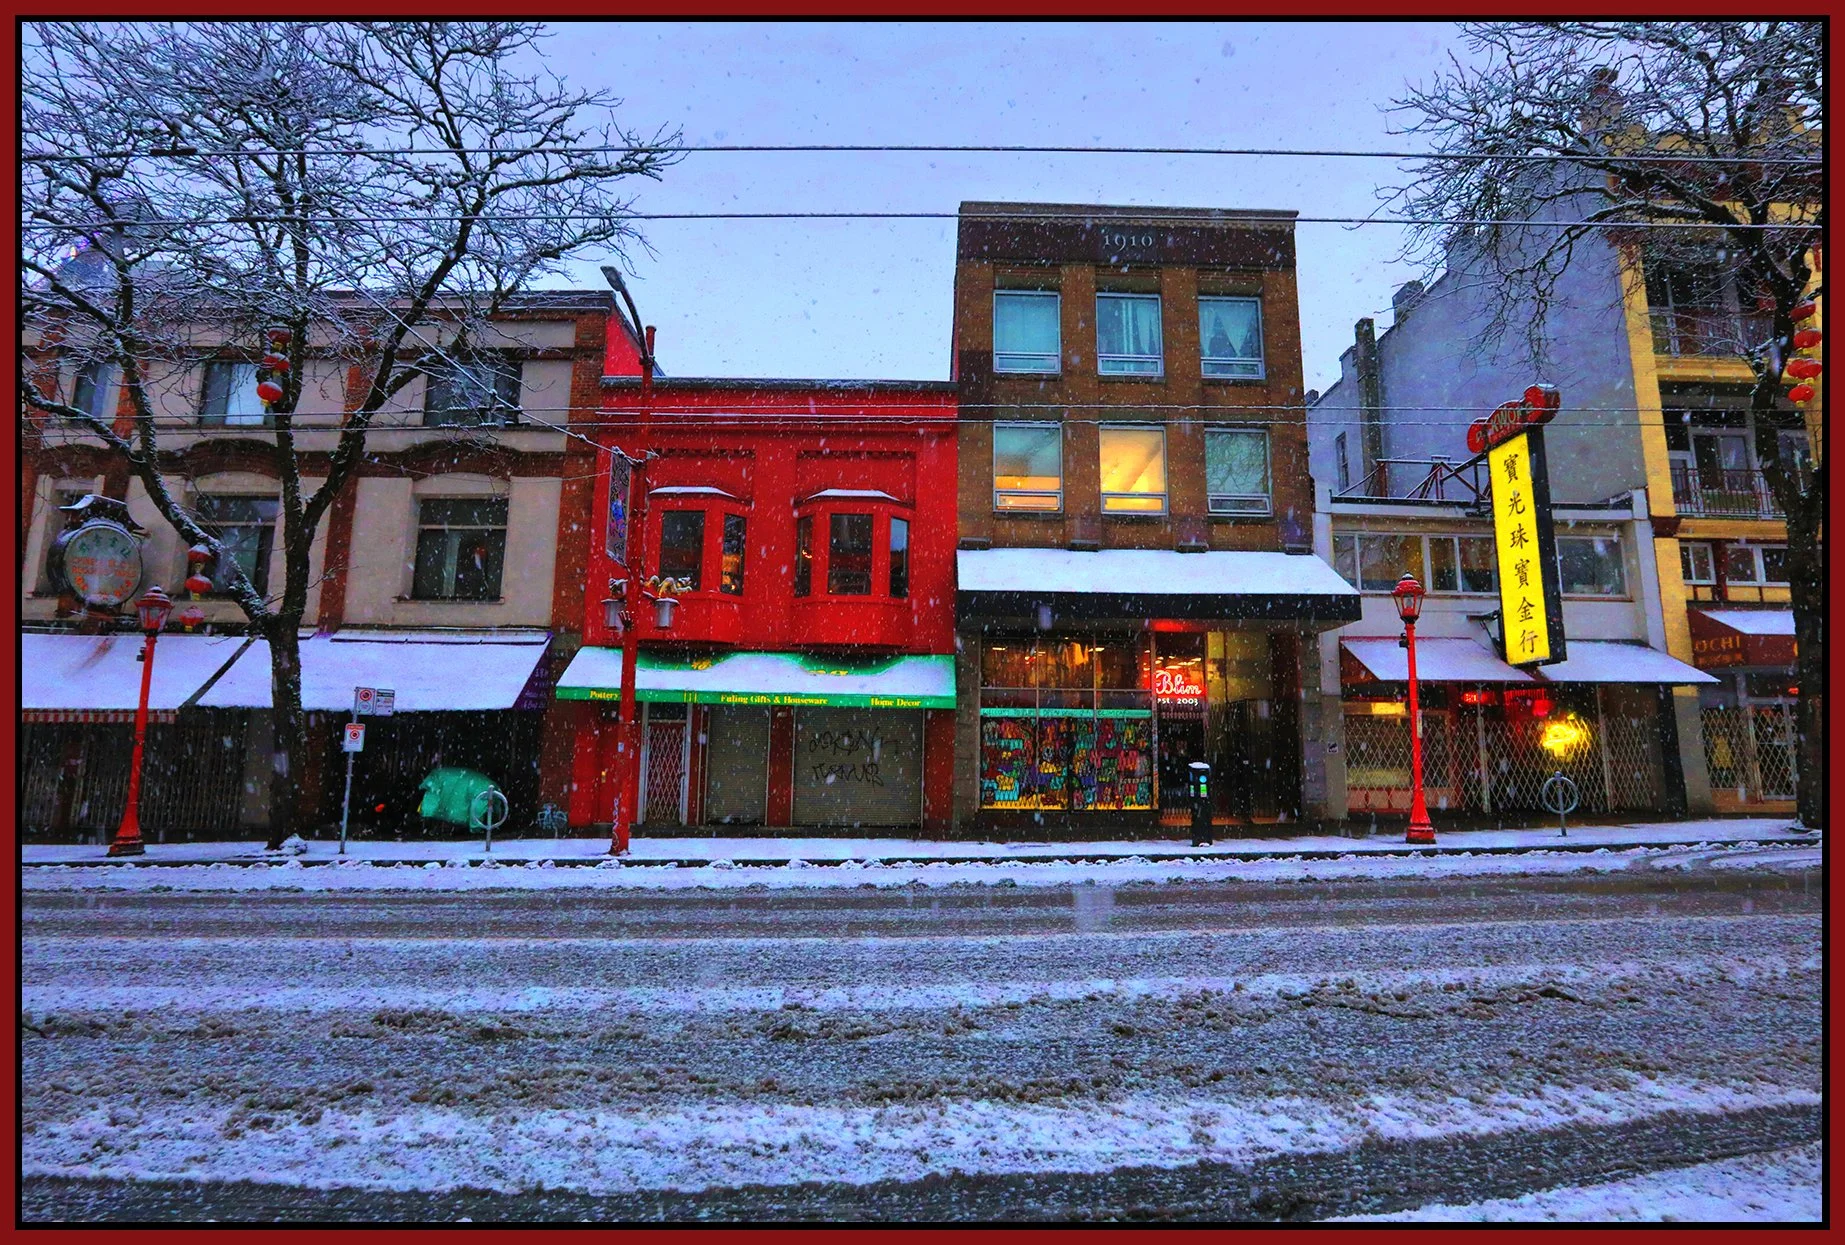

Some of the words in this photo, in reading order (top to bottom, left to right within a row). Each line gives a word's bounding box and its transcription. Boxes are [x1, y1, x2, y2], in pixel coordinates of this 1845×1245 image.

[1104, 234, 1153, 252] 1910
[1503, 453, 1540, 654] 寶光珠寶金行
[1155, 670, 1202, 694] Blim
[590, 690, 618, 700] Pottery
[750, 695, 771, 703] Gifts
[774, 696, 781, 704] &
[784, 696, 828, 704] Houseware
[871, 697, 894, 706] Home
[896, 698, 921, 706] Decor
[1177, 698, 1199, 707] 2003
